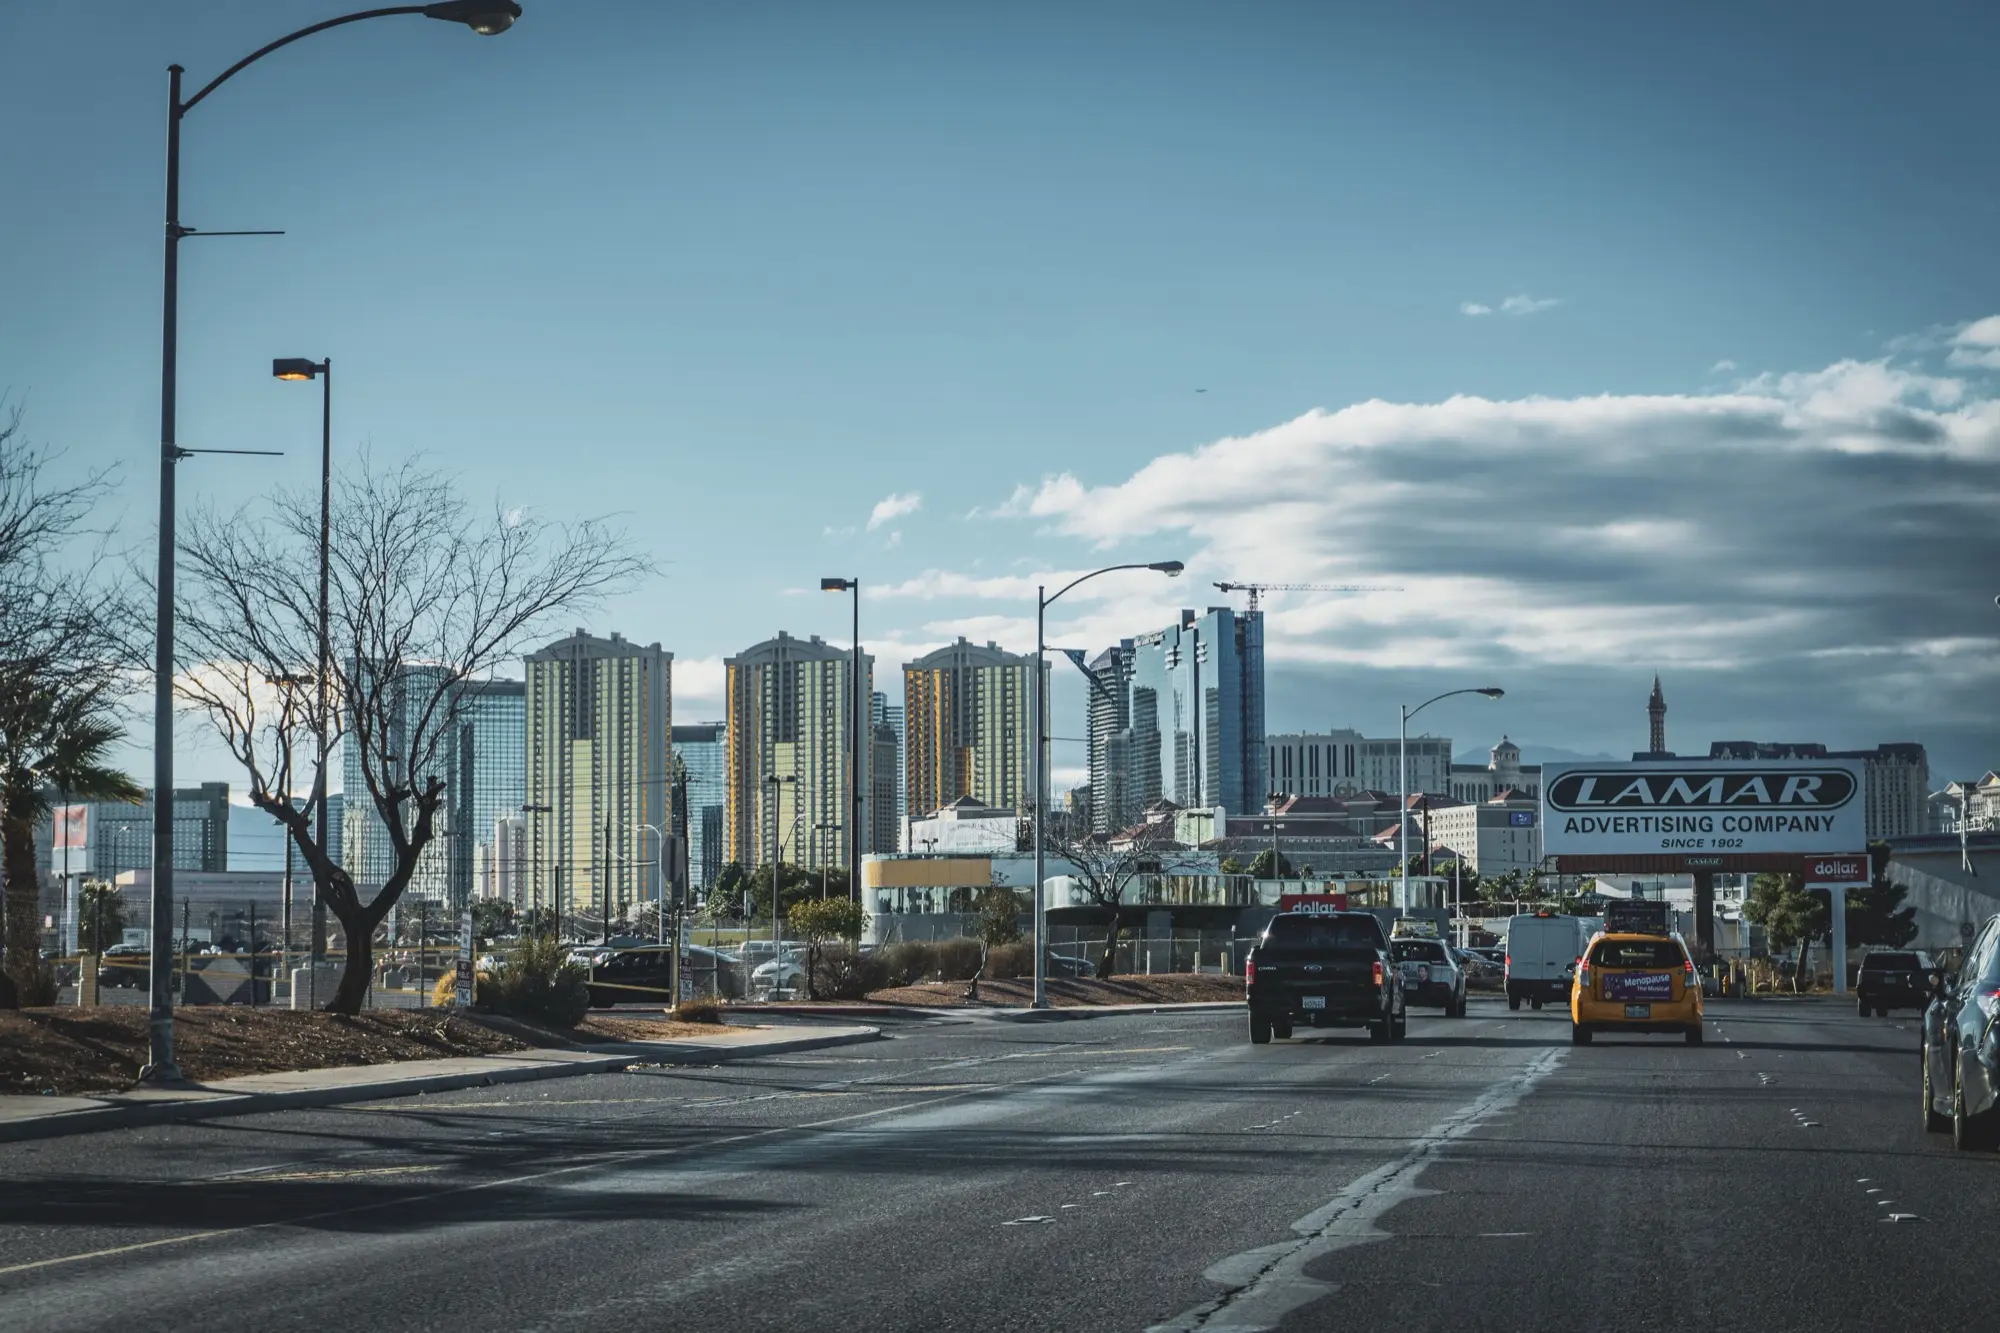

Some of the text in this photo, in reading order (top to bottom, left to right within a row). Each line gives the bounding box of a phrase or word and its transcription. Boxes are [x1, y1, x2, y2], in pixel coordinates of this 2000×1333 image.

[1575, 776, 1823, 804] LAMAR
[1564, 815, 1835, 834] ADVERTISING COMPANY
[1661, 838, 1744, 849] SINCE 1902
[1624, 974, 1670, 987] Menopause
